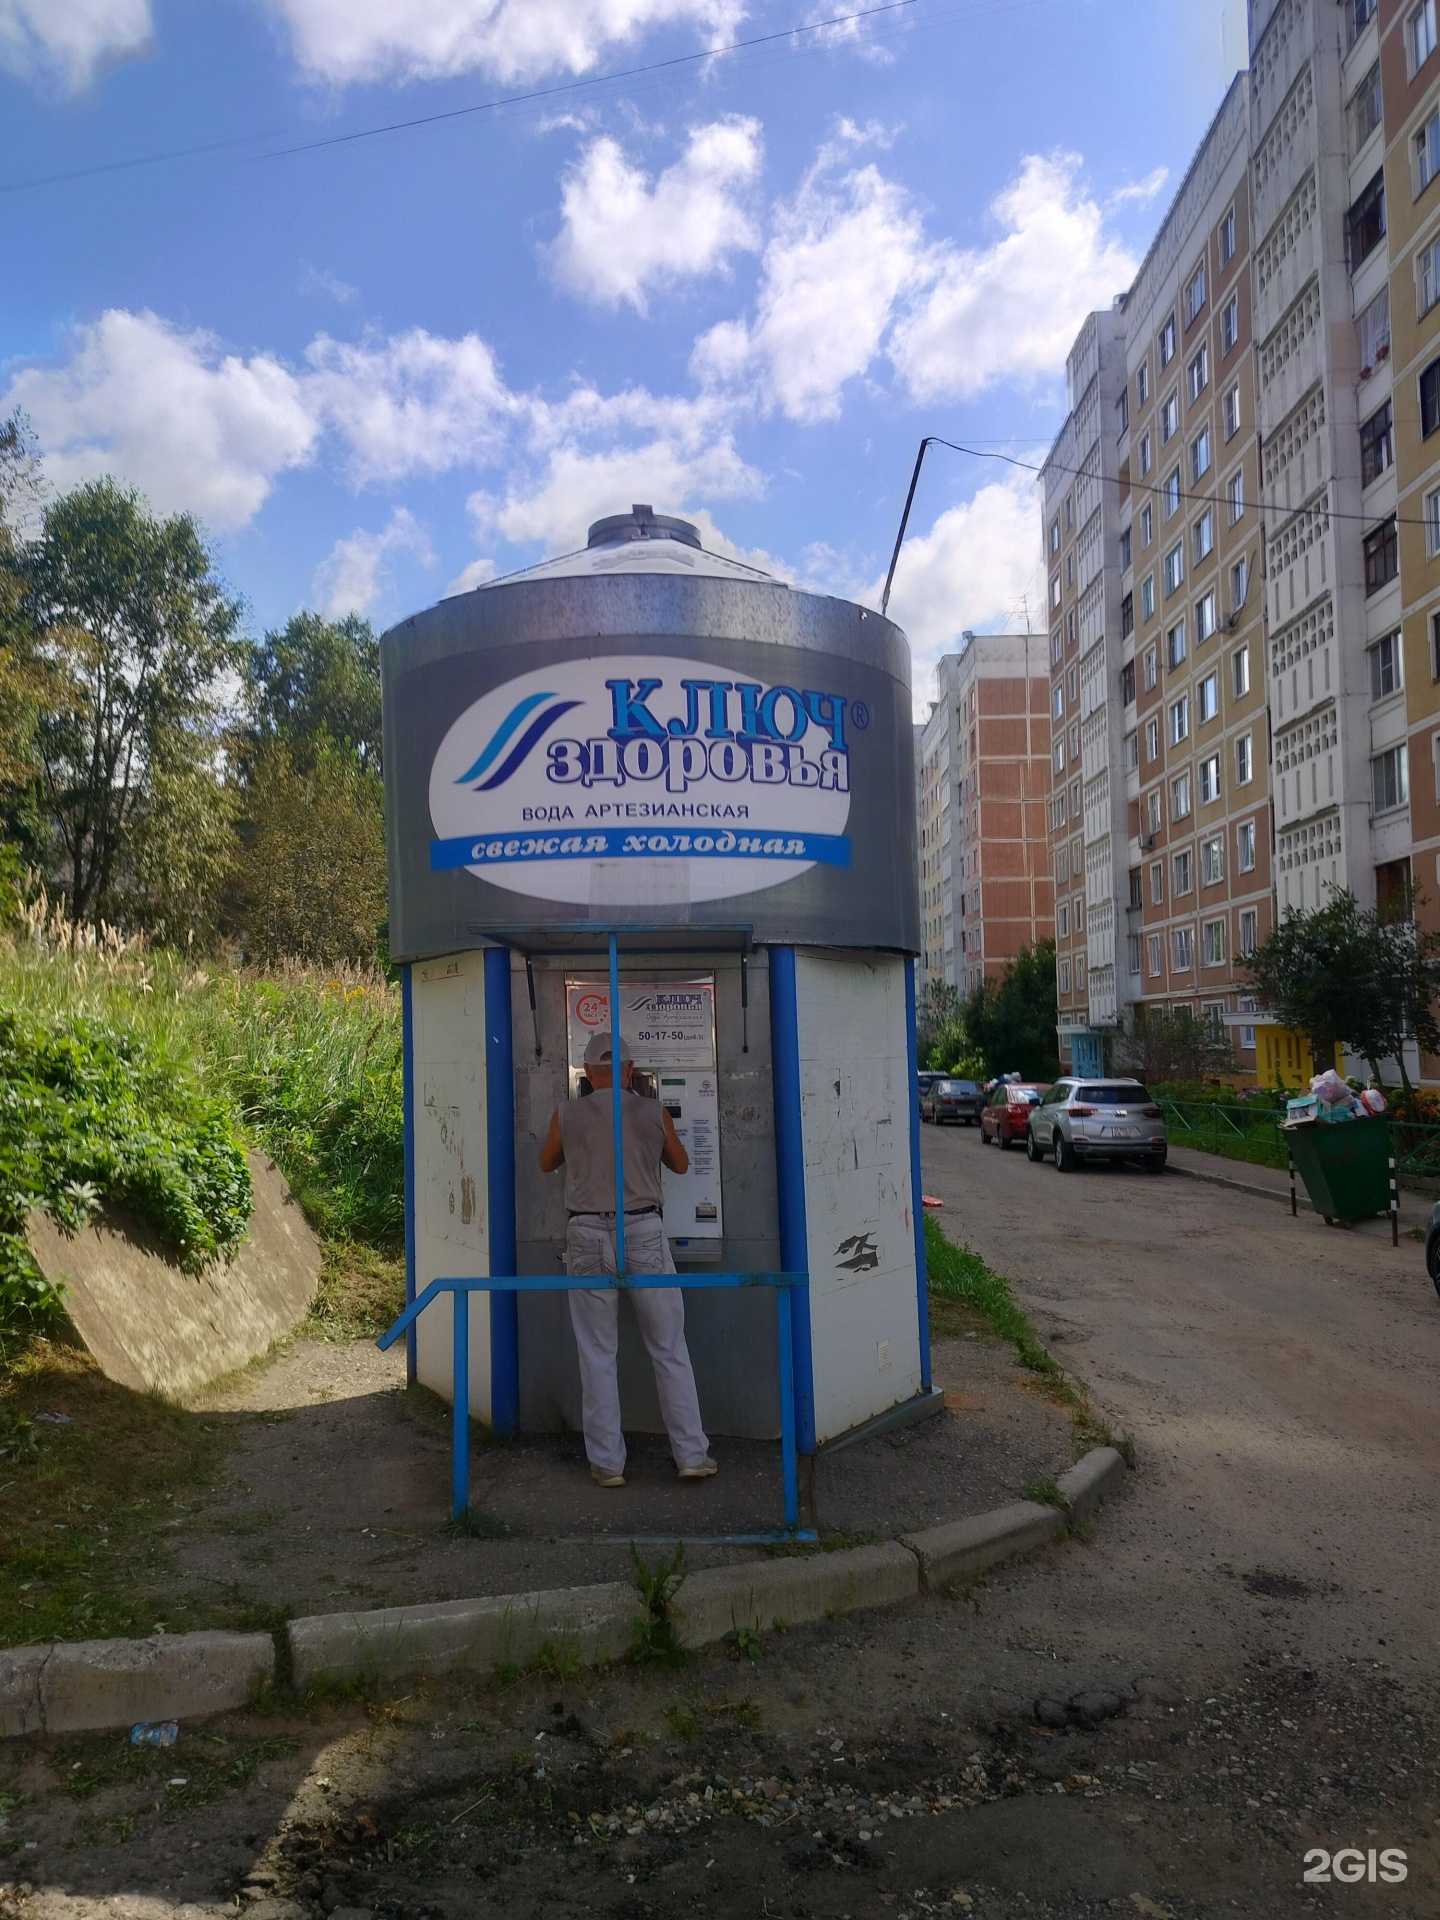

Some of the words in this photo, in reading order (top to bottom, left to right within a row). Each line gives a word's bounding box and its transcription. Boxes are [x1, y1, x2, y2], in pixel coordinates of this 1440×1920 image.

[605, 678, 848, 751] КЛЮЧ
[522, 804, 574, 823] ВОДА
[585, 802, 750, 820] АРТЕЗИАНСКАЯ
[471, 835, 609, 860] свежая
[622, 831, 807, 856] холодная
[638, 1031, 683, 1041] 50-17-50
